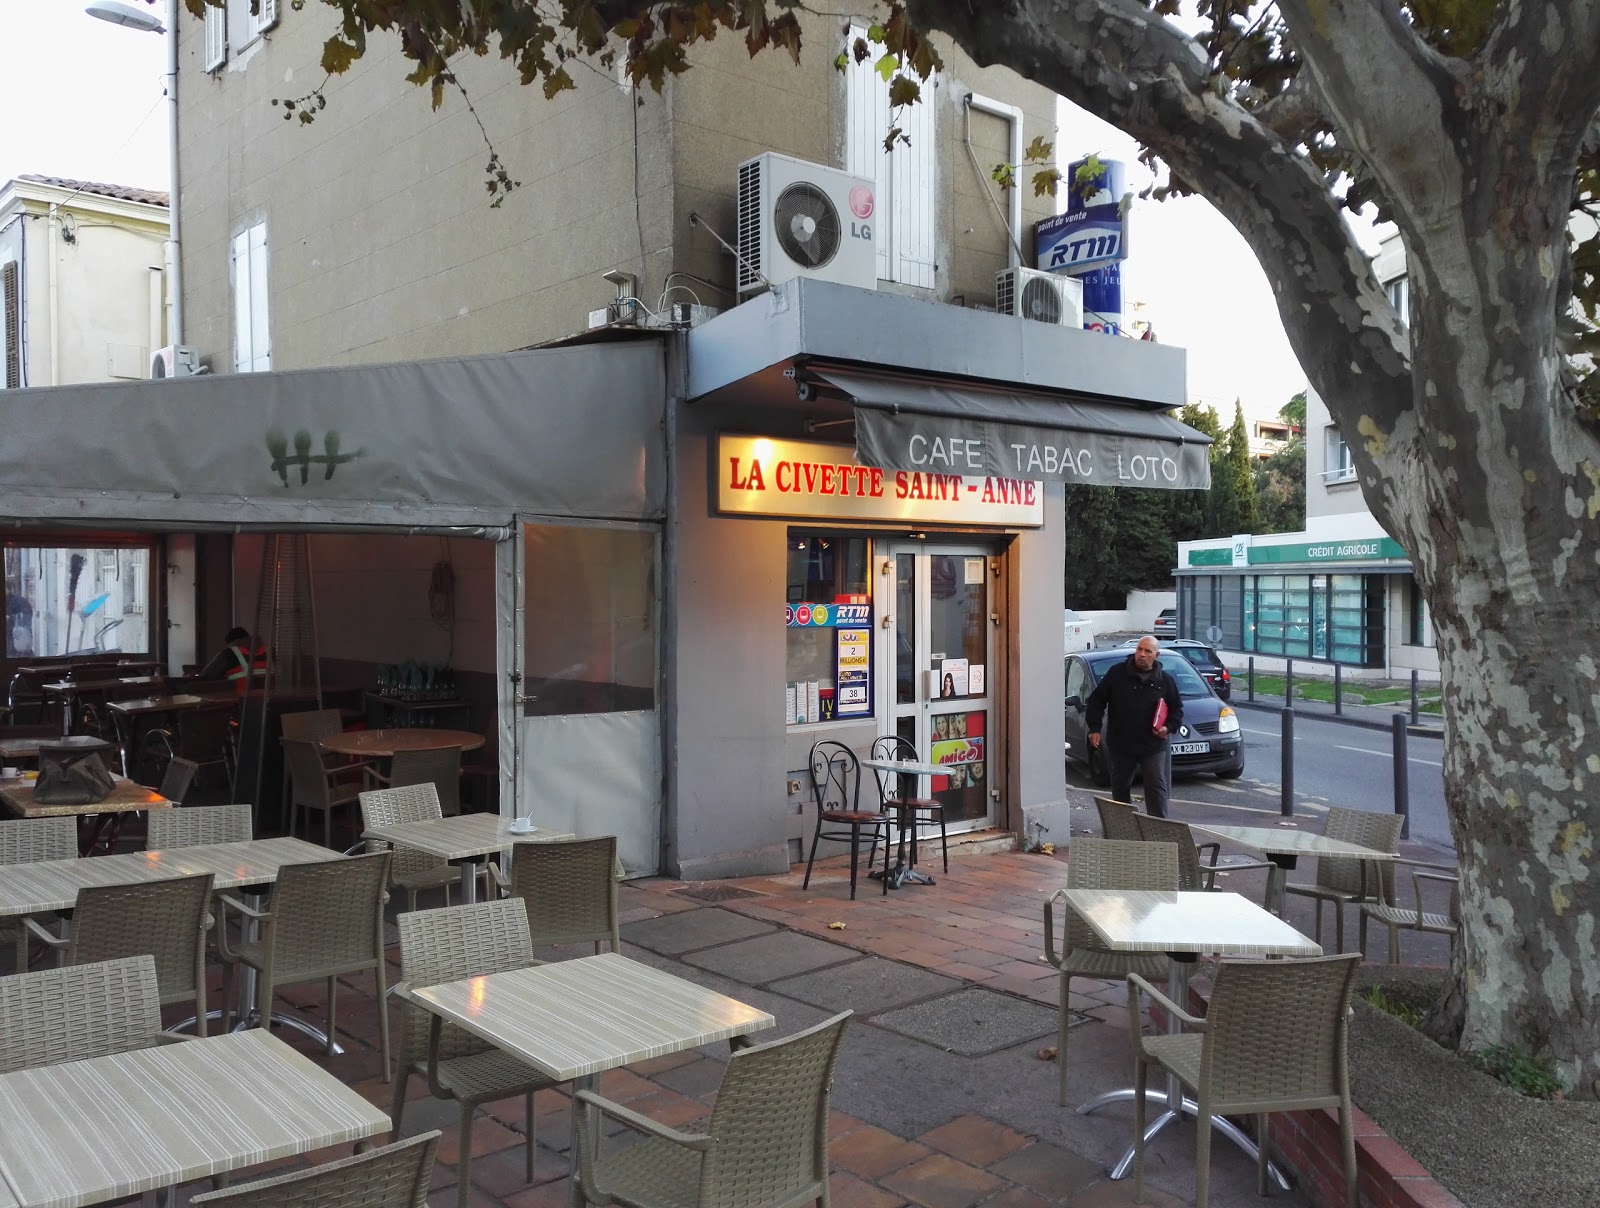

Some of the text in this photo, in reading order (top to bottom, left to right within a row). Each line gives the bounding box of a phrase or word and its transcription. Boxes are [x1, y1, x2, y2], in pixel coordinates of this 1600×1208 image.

[851, 221, 872, 241] LG
[1038, 211, 1087, 233] point de vente
[1050, 234, 1117, 267] RTM
[908, 434, 1178, 482] CAFE TABAC LOTO
[729, 456, 766, 491] LA
[775, 460, 885, 498] CIVETTE
[895, 470, 963, 502] SAINT
[981, 475, 1036, 506] ANNE
[1308, 543, 1378, 557] CRÉDIT AGRICOLE
[837, 605, 869, 617] RTM
[851, 646, 856, 655] 2
[849, 689, 858, 698] 38
